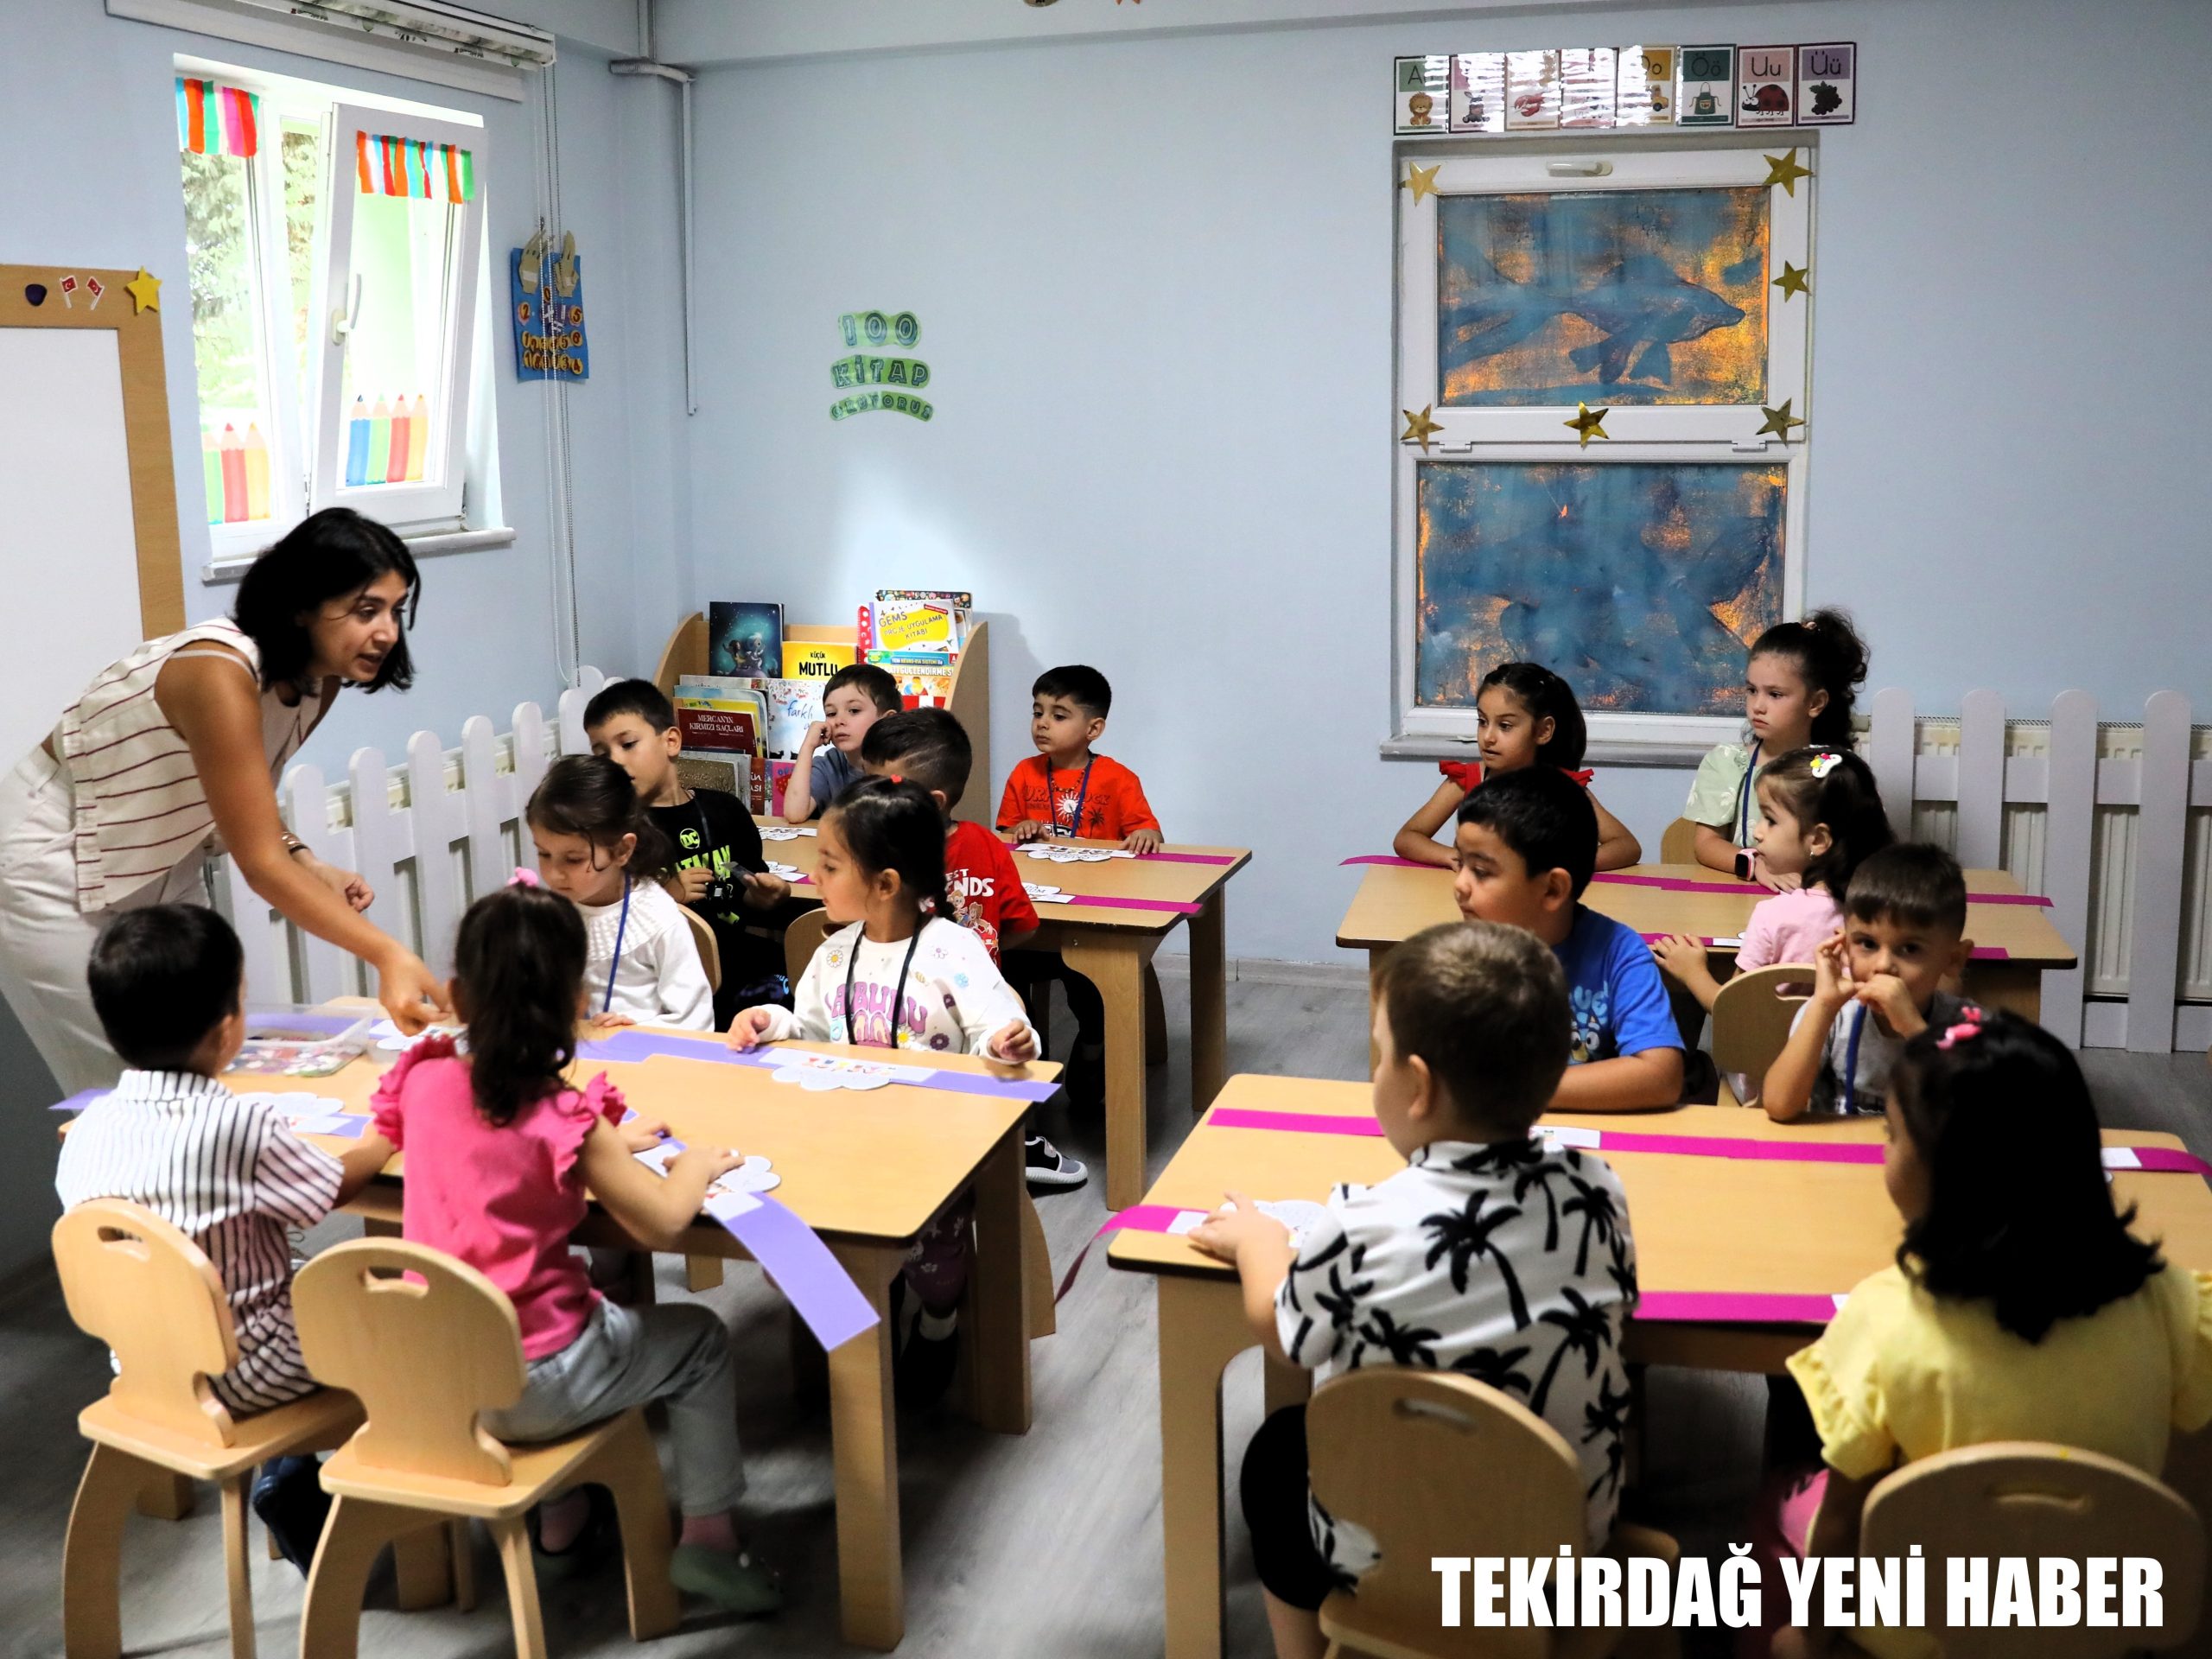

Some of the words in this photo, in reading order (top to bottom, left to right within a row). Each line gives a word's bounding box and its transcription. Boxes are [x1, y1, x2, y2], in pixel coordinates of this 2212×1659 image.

[1691, 53, 1721, 77] Öö
[1751, 56, 1781, 77] Uu
[1811, 50, 1841, 76] Üü
[842, 312, 918, 346] 100
[832, 354, 929, 388] KİTAP
[879, 611, 908, 628] GEMS
[798, 661, 838, 677] MUTLU
[680, 832, 699, 848] DC
